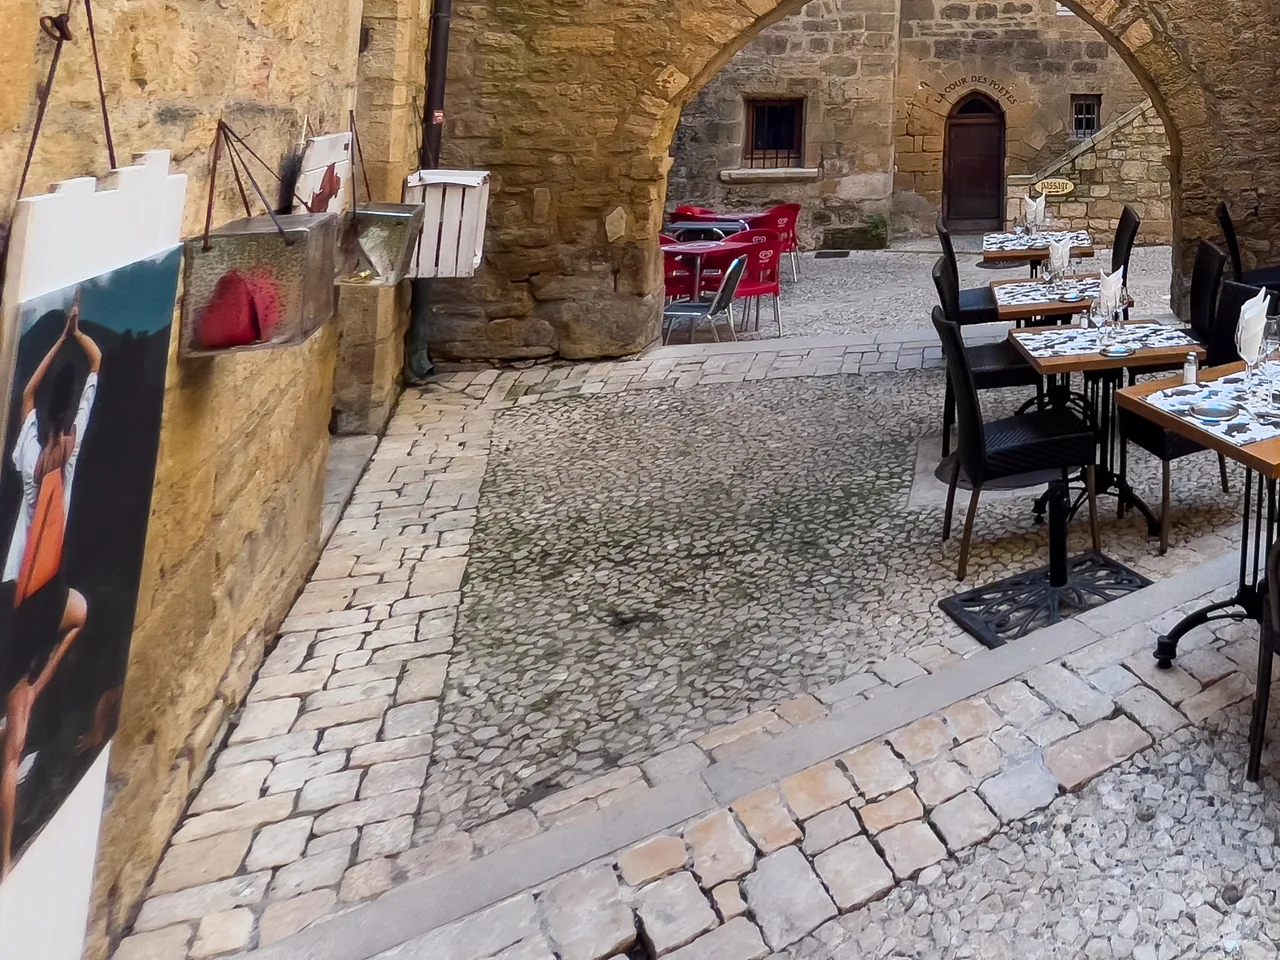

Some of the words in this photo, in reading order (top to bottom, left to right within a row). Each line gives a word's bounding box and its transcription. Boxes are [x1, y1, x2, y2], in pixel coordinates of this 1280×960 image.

[934, 91, 946, 104] LA
[944, 77, 968, 94] COUR
[970, 75, 988, 84] DES
[988, 79, 1018, 105] POETES
[1041, 181, 1069, 192] passage
